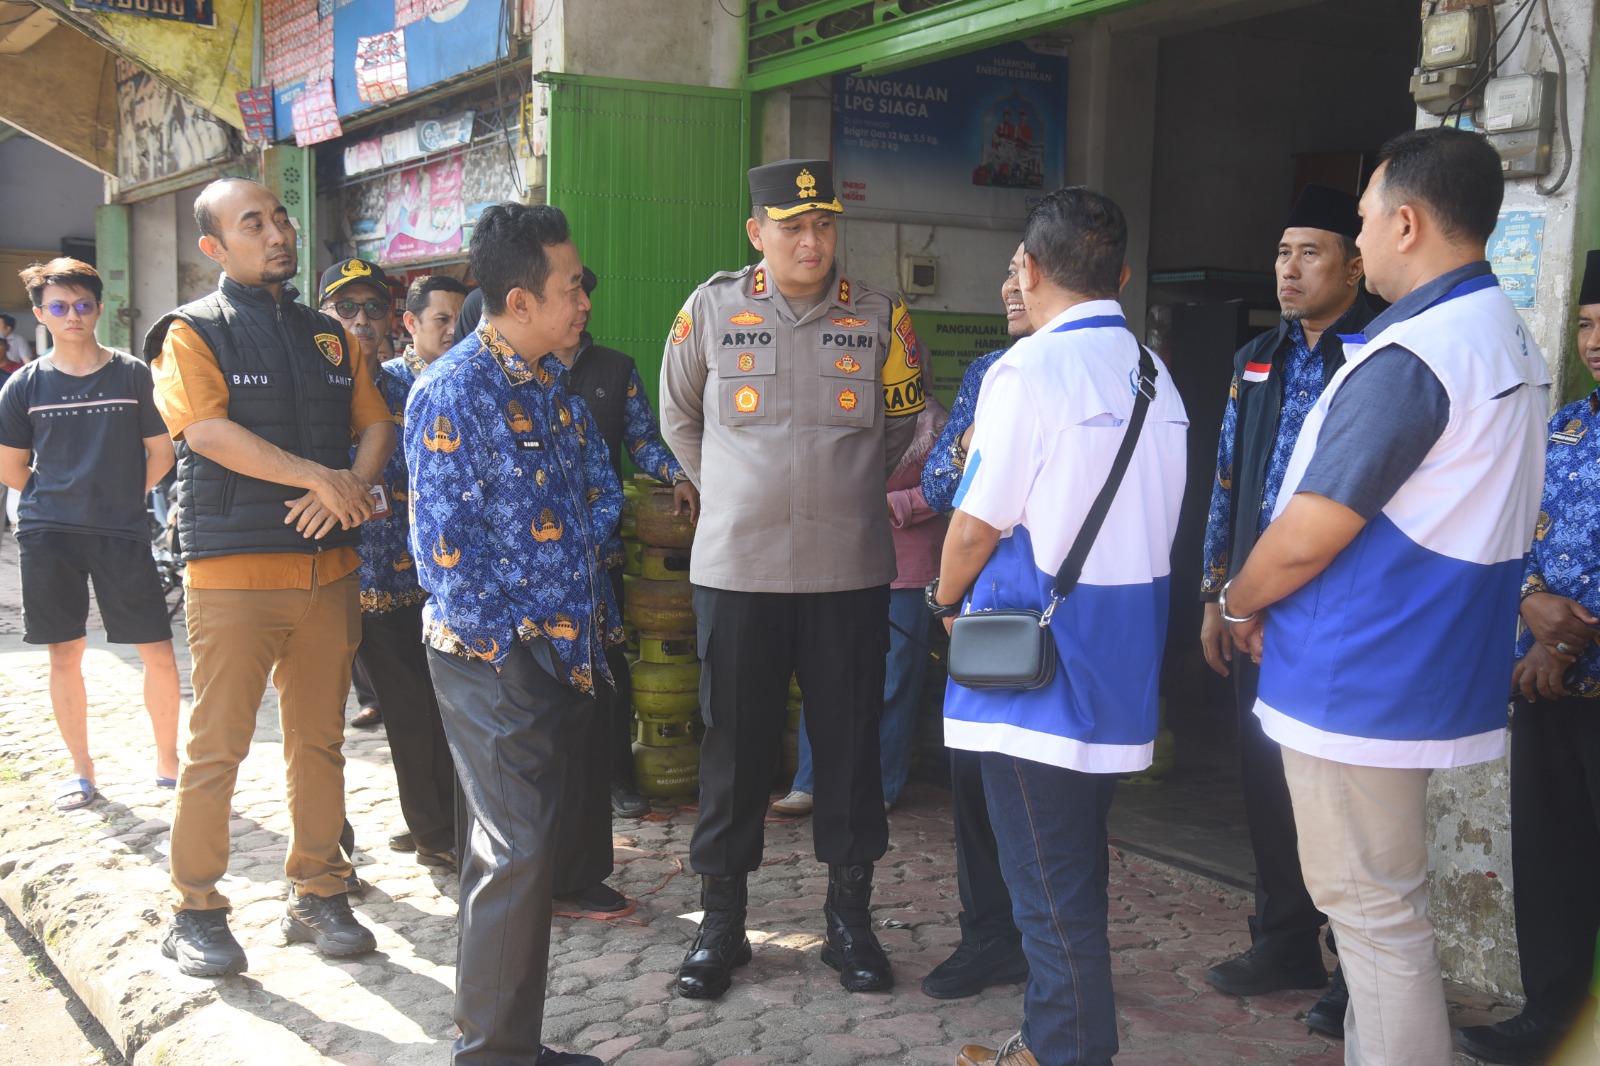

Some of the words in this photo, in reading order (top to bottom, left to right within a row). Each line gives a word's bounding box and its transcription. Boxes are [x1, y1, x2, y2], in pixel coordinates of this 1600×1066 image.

[993, 57, 1036, 71] HARMONI
[976, 64, 1007, 77] ENERGI
[1008, 69, 1052, 82] KEBAIKAN
[845, 76, 948, 102] PANGKALAN
[844, 95, 874, 112] LPG
[879, 98, 929, 118] SIAGA
[843, 127, 868, 138] Bright
[870, 129, 886, 139] Gas
[888, 131, 897, 139] 12
[887, 142, 899, 152] kg
[936, 323, 998, 335] PANGKALAN
[1001, 326, 1009, 336] L
[721, 332, 772, 346] ARYO
[822, 333, 873, 348] POLRI
[232, 374, 268, 385] BAYU
[41, 410, 78, 418] DENIM
[86, 406, 124, 414] MAKER
